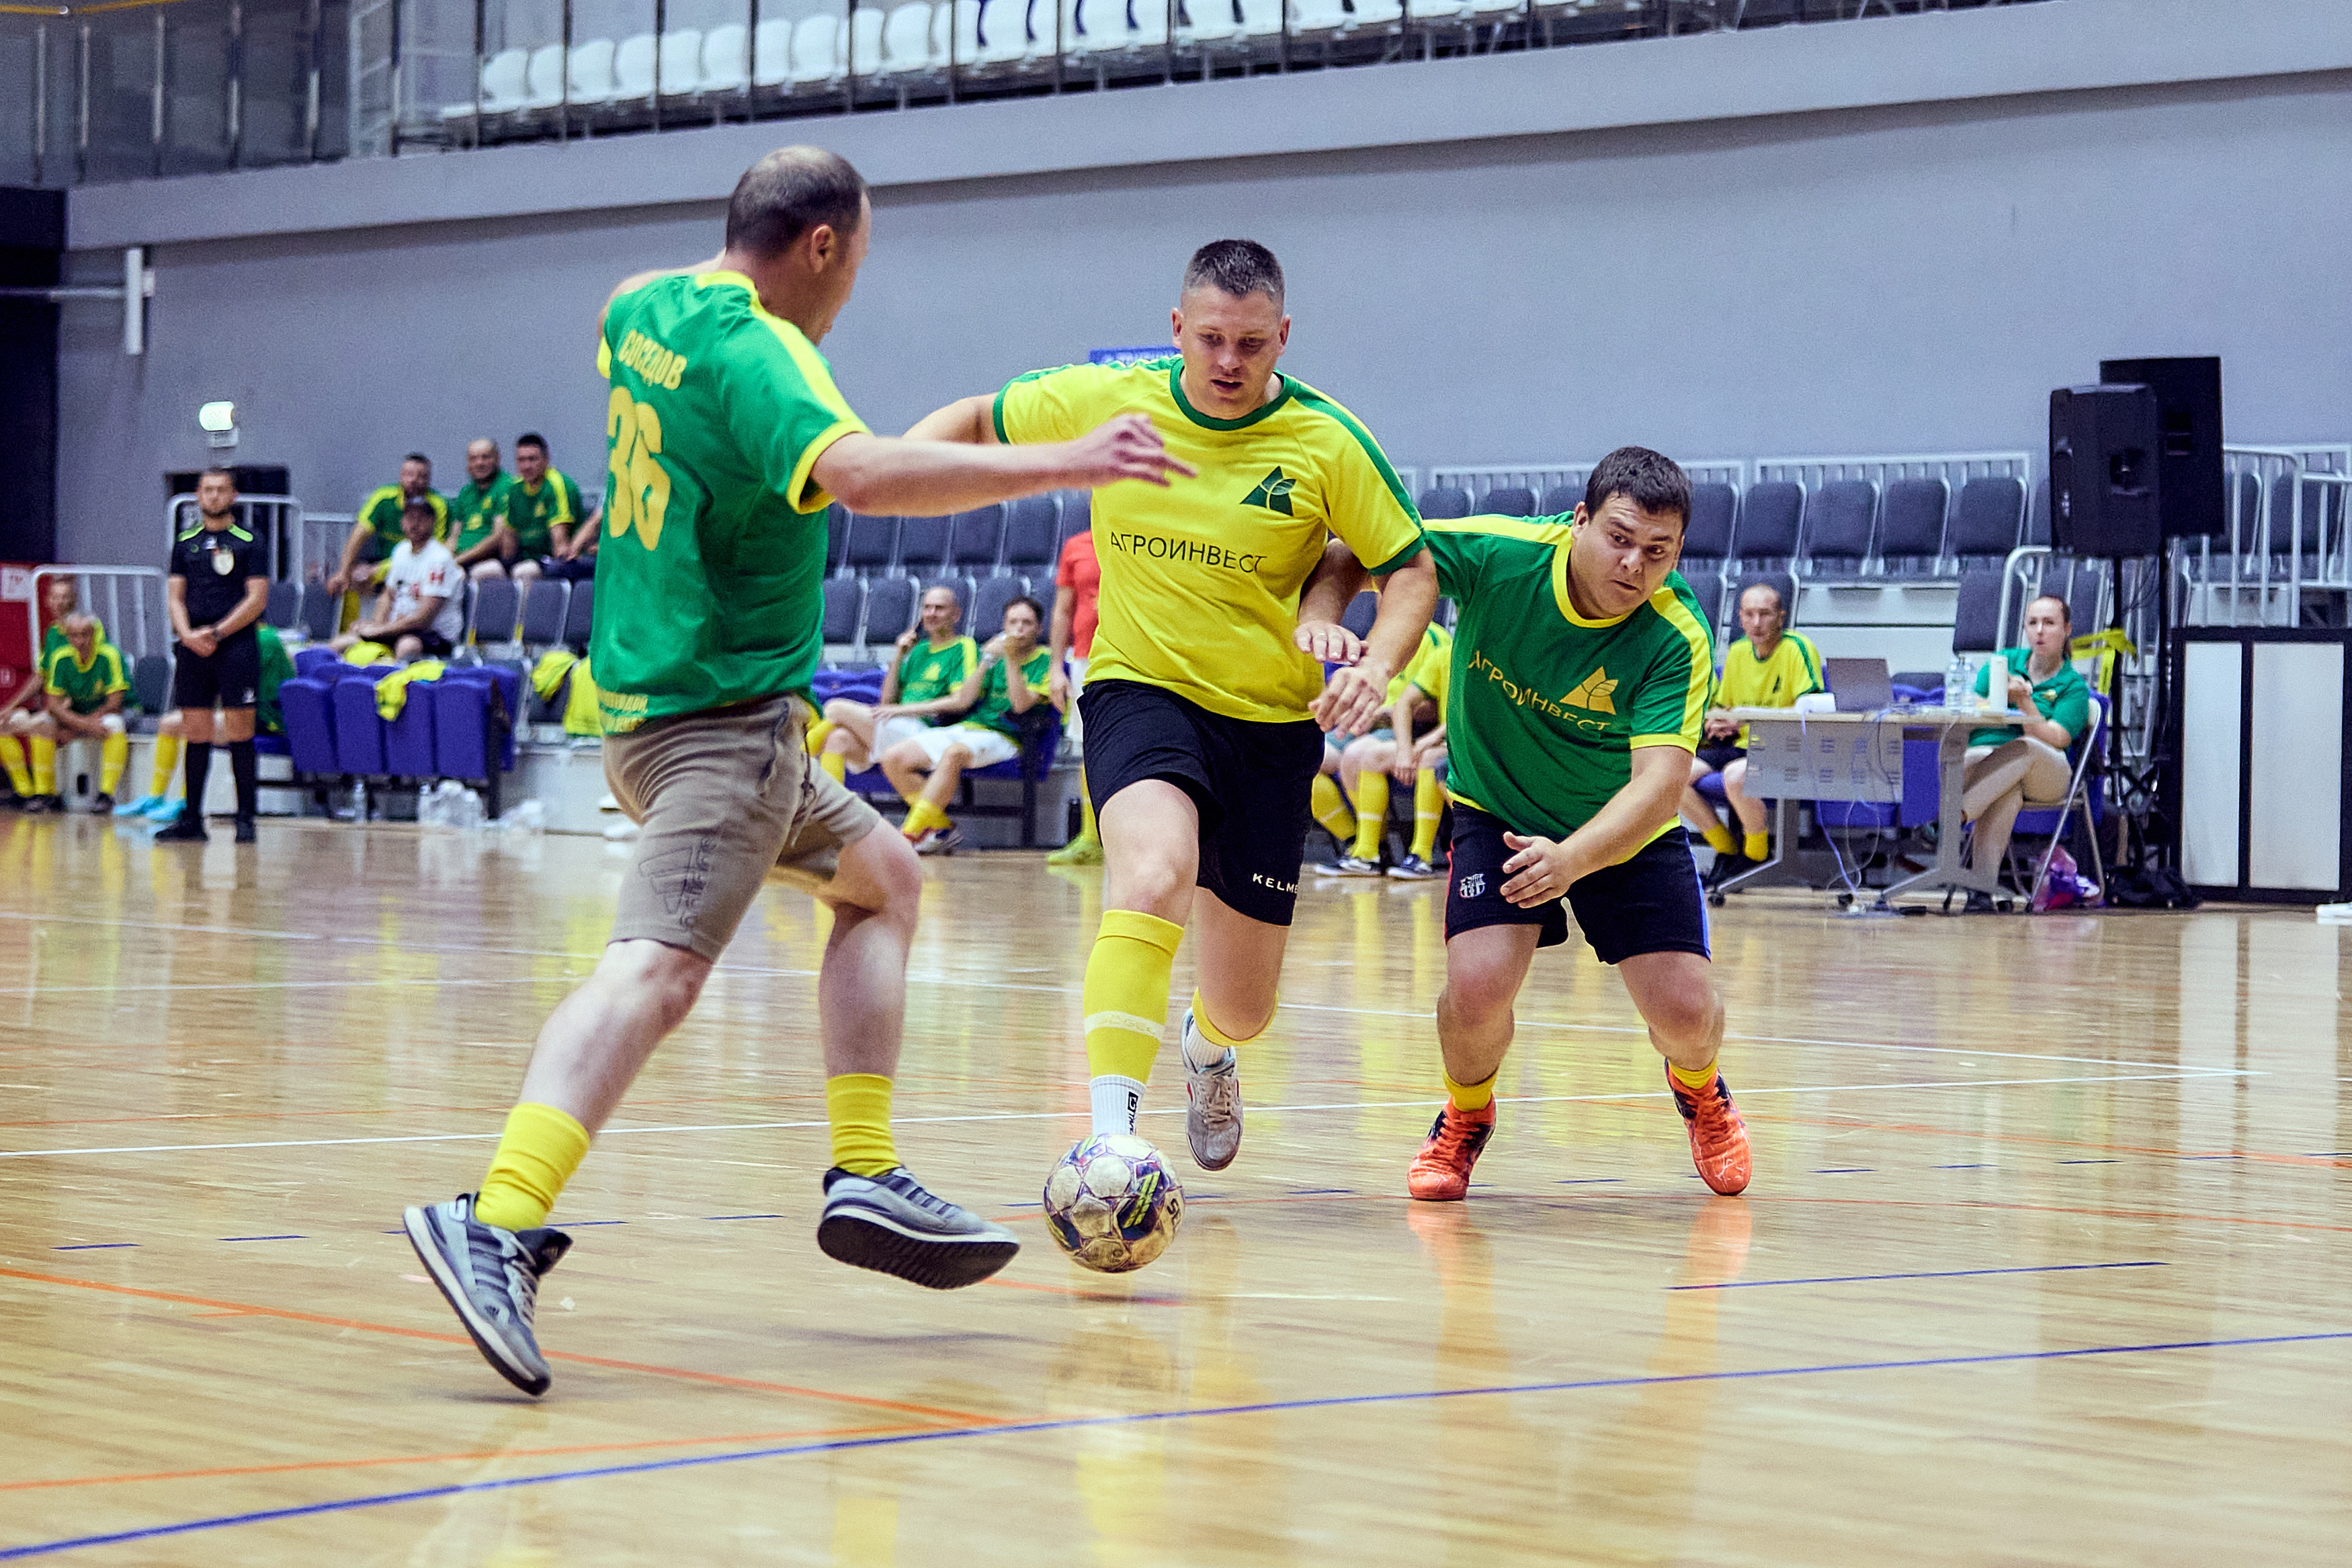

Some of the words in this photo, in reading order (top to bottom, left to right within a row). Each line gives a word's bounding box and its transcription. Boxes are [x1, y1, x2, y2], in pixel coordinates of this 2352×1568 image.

[607, 386, 671, 552] 36
[1110, 531, 1268, 573] АГРОИНВЕСТ
[1468, 650, 1611, 731] АГРОИНВЕСТ
